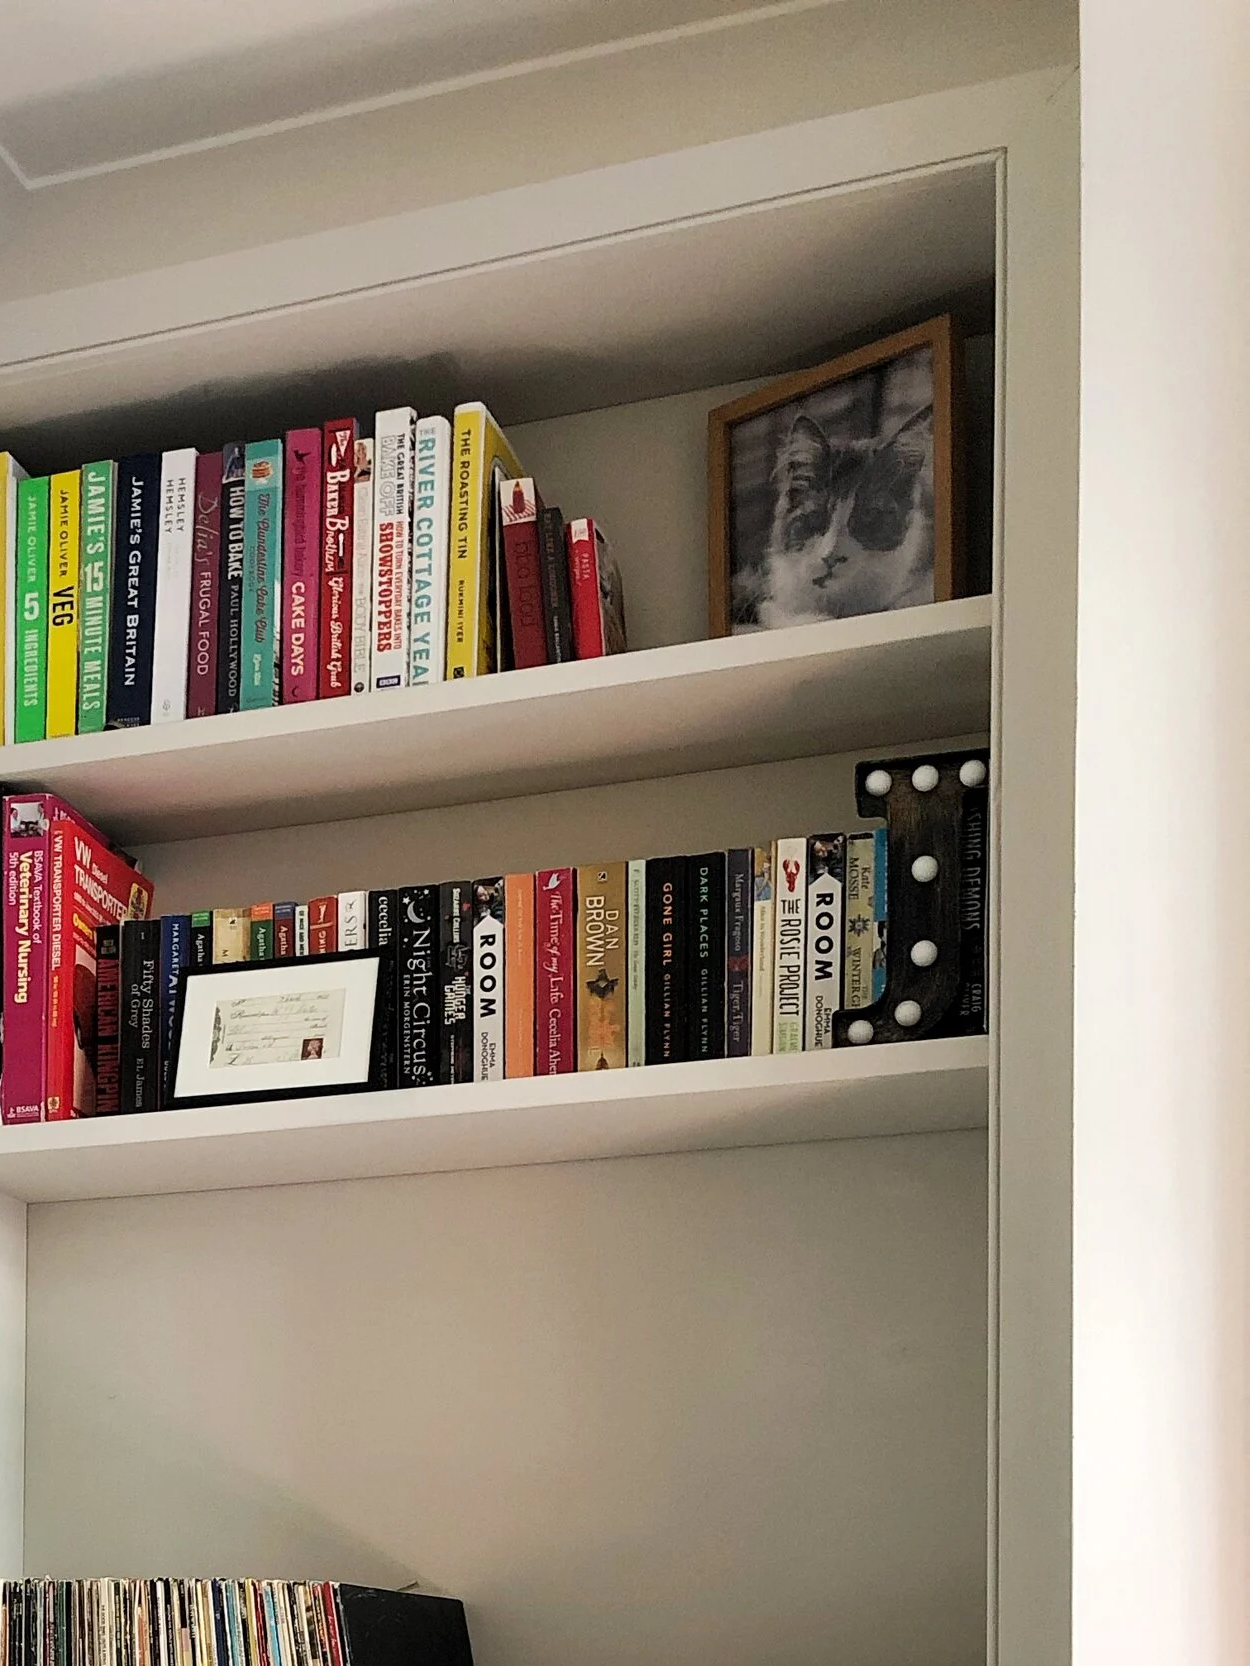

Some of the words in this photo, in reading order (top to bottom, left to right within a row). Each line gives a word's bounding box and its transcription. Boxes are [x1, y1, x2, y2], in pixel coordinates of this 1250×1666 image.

[379, 435, 396, 479] BAKE
[396, 433, 405, 450] THE
[460, 429, 471, 456] THE
[396, 452, 405, 481] GREAT
[416, 438, 437, 511] RIVER
[27, 495, 40, 533] JAMIE
[59, 489, 70, 527] JAMIE
[87, 471, 107, 555] JAMIE'S
[129, 476, 145, 544] JAMIE'S
[163, 479, 175, 535] HEMSLEY
[175, 477, 188, 533] HEMSLEY
[230, 486, 245, 519] HOW
[257, 493, 271, 517] The
[378, 481, 395, 517] OFF
[395, 482, 404, 515] BRITISH
[457, 461, 470, 531] ROASTING
[194, 494, 220, 563] Delia's
[229, 521, 244, 540] TO
[395, 520, 404, 539] HOW
[395, 540, 403, 550] TO
[26, 536, 38, 584] OLIVER
[58, 530, 70, 578] OLIVER
[226, 542, 243, 580] BAKE
[394, 551, 403, 570] TURN
[457, 538, 467, 559] TIN
[581, 552, 590, 581] PASTA
[84, 560, 105, 593] 15
[127, 550, 142, 609] GREAT
[376, 522, 394, 654] SHOWSTOPPERS
[393, 571, 404, 607] EVERYDAY
[413, 517, 435, 624] COTTAGE
[23, 591, 40, 621] 5
[52, 585, 75, 628] VEG
[197, 570, 212, 627] FRUGAL
[229, 584, 241, 617] PAUL
[254, 585, 269, 616] Cake
[290, 581, 306, 629] CAKE
[326, 577, 345, 620] Glorious
[456, 580, 465, 618] RUKMINI
[83, 596, 103, 653] MINUTE
[253, 618, 268, 644] Club
[392, 608, 403, 632] BAKES
[455, 621, 464, 643] IYER
[123, 614, 140, 687] BRITAIN
[195, 631, 211, 676] FOOD
[228, 619, 240, 698] HOLLYWOOD
[289, 632, 306, 677] DAYS
[328, 620, 344, 659] British
[392, 632, 402, 650] INTO
[22, 629, 40, 708] INGREDIENTS
[80, 659, 100, 712] MEALS
[326, 660, 342, 688] Grub
[8, 852, 19, 869] 5th
[52, 835, 64, 854] VW
[73, 836, 92, 869] VW
[33, 850, 44, 882] BSAVA
[699, 867, 709, 903] DARK
[849, 857, 861, 900] MOSSE
[861, 867, 871, 890] Kate
[8, 871, 20, 905] edition
[16, 851, 33, 936] Veterinary
[32, 885, 44, 928] Textbook
[51, 855, 64, 932] TRANSPORTER
[74, 863, 129, 921] TRANSPORTER
[662, 882, 673, 926] GONE
[731, 873, 745, 913] Margaux
[780, 899, 801, 915] THE
[32, 932, 43, 944] of
[279, 925, 290, 955] Agatha
[377, 895, 393, 947] cecelia
[451, 917, 461, 944] COLLINS
[548, 910, 565, 944] Time
[585, 896, 605, 968] BROWN
[605, 910, 620, 950] DAN
[699, 908, 709, 958] PLACES
[731, 915, 744, 952] Fragoso
[814, 892, 834, 982] ROOM
[51, 934, 63, 971] DIESEL
[171, 923, 180, 976] MARGARET
[195, 934, 206, 963] Agatha
[258, 926, 268, 957] Agatha
[662, 932, 673, 967] GIRL
[14, 942, 32, 1003] Nursing
[141, 960, 156, 994] Fifty
[406, 929, 433, 996] Night
[479, 933, 497, 1019] ROOM
[851, 947, 862, 994] WINTER
[97, 959, 120, 1037] AMERICAN
[130, 983, 142, 995] of
[402, 974, 411, 997] ERIN
[453, 976, 468, 1021] HUNGER
[548, 975, 565, 1003] Life
[662, 972, 671, 1017] GILLIAN
[700, 968, 709, 1013] GILLIAN
[778, 965, 801, 1017] PROJECT
[969, 982, 983, 1014] CRAIG
[128, 999, 142, 1028] Grey
[140, 998, 156, 1049] Shades
[443, 984, 456, 1026] GAMES
[814, 995, 825, 1047] DONOGHUE
[823, 1007, 832, 1034] EMMA
[402, 1001, 412, 1075] MORGENSTERN
[411, 1001, 432, 1076] Circus
[549, 1007, 564, 1047] Cecelia
[662, 1023, 671, 1059] FLYNN
[700, 1018, 708, 1054] FLYNN
[730, 1014, 743, 1043] Tiger
[480, 1031, 489, 1081] DONOGHUE
[489, 1042, 497, 1069] EMMA
[548, 1049, 561, 1077] Aher
[95, 1043, 119, 1113] KINGPIN
[134, 1073, 146, 1108] James
[16, 1105, 39, 1114] BSAVA
